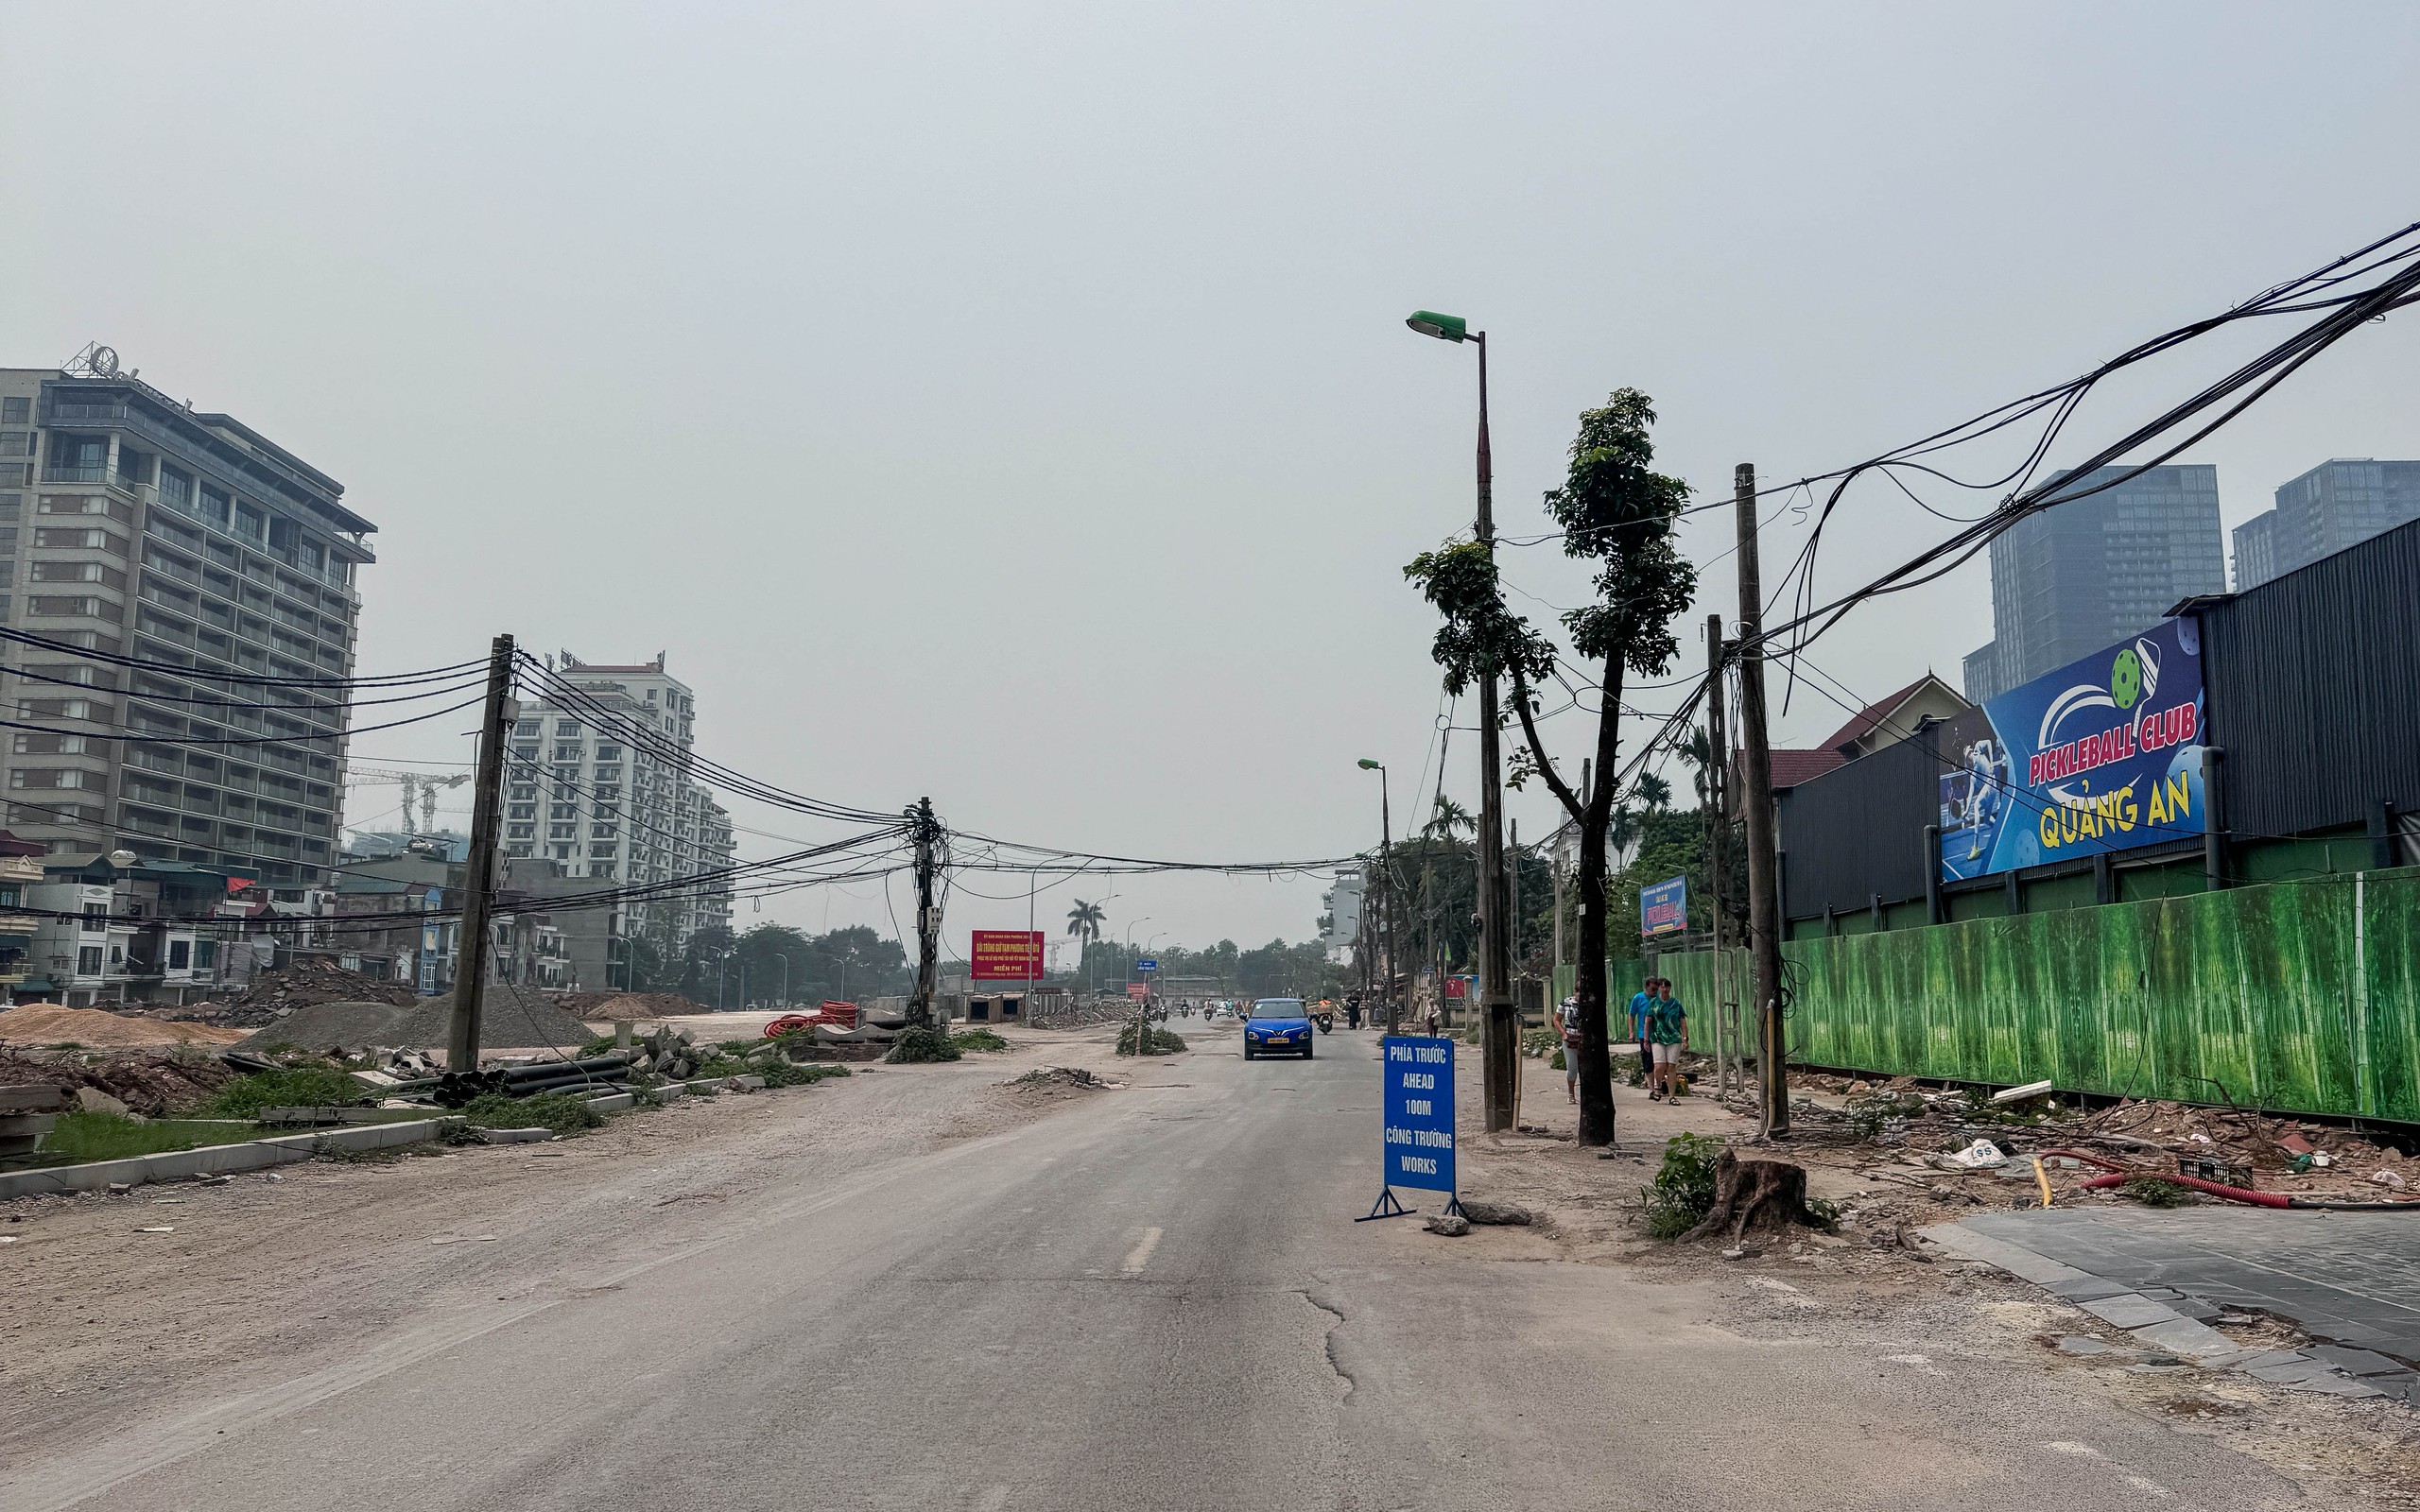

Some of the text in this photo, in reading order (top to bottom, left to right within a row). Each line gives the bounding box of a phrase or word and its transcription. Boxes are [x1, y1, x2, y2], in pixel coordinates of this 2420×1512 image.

[2029, 702, 2197, 788] PICKLEBALL CLUB
[2039, 770, 2190, 849] QUẢNG AN
[1391, 1044, 1446, 1064] PHÍA TRƯỚC
[1403, 1073, 1435, 1090] AHEAD
[1405, 1099, 1431, 1116] 100M
[1386, 1125, 1452, 1149] CÔNG TRƯỜNG
[1401, 1156, 1437, 1175] WORKS
